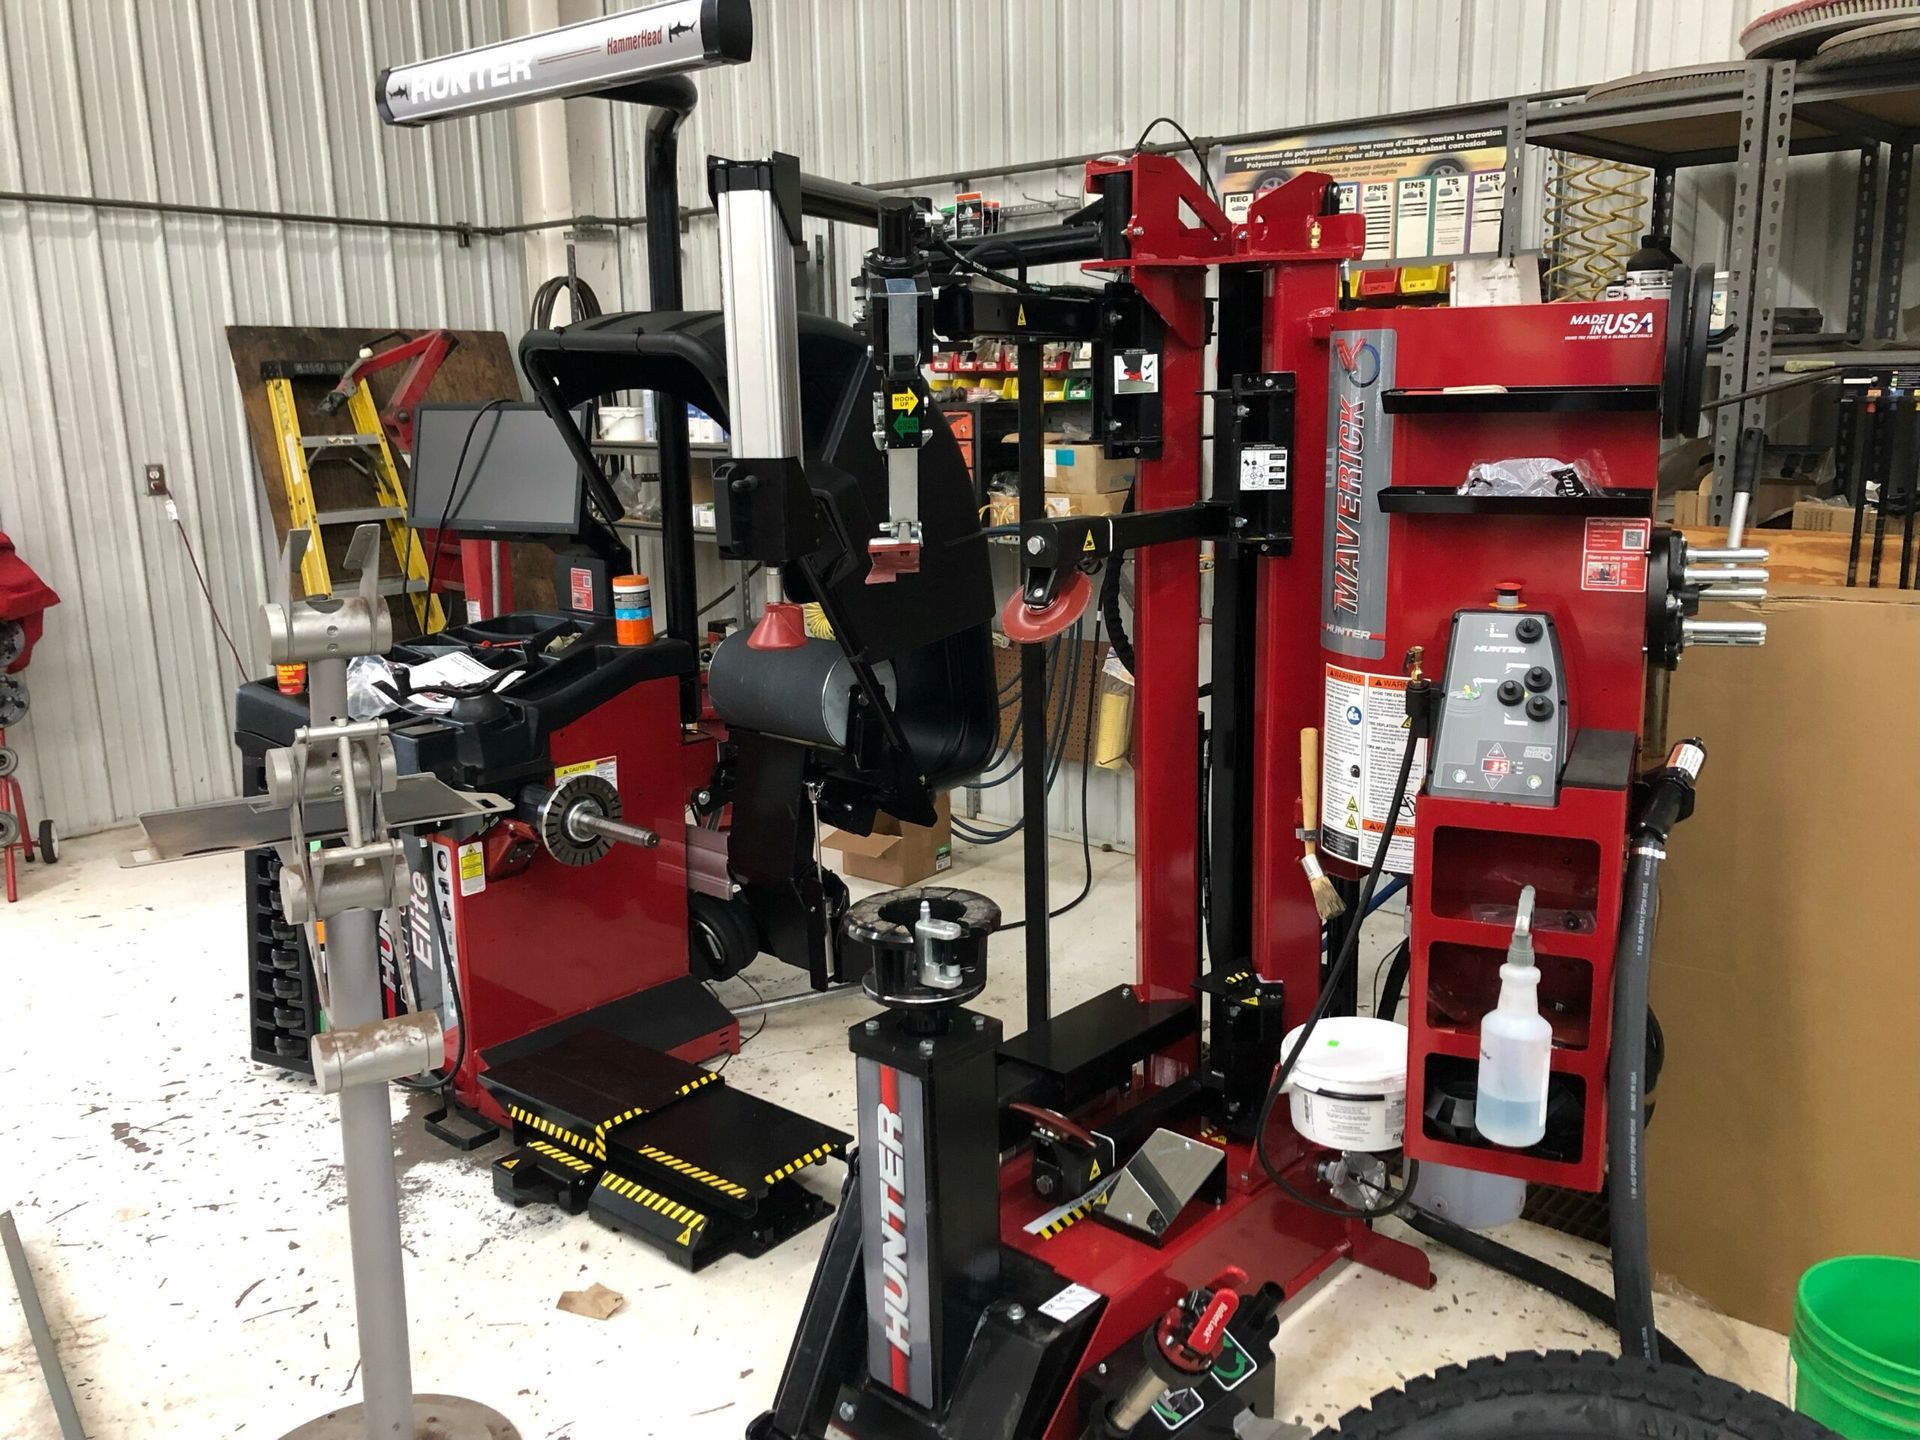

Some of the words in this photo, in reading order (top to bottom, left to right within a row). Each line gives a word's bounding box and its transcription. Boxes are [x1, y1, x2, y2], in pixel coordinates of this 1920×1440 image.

[606, 25, 663, 55] HammerHead
[411, 57, 532, 105] HUNTER
[1244, 152, 1283, 162] revêtement
[1295, 147, 1328, 157] polyester
[1329, 144, 1357, 155] protège
[1430, 135, 1455, 143] contre
[1466, 129, 1502, 139] corrosion
[1247, 160, 1280, 169] Polyester
[1282, 157, 1310, 167] coating
[1312, 154, 1343, 164] protects
[1344, 152, 1363, 160] your
[1365, 149, 1384, 158] alloy
[1386, 147, 1414, 155] wheels
[1415, 143, 1446, 153] against
[1448, 139, 1487, 150] corrosion
[1404, 181, 1425, 189] ENS
[1479, 175, 1500, 183] LHS
[1570, 314, 1607, 325] MADE
[1589, 325, 1604, 334] IN
[1604, 312, 1653, 334] USA
[1334, 394, 1365, 615] MAVERICK
[1326, 624, 1371, 640] HUNTER
[1473, 645, 1526, 654] HUNTER
[569, 764, 591, 773] CAUTION
[410, 871, 434, 970] Elite
[1638, 915, 1646, 935] SPRAY
[877, 1102, 910, 1358] HUNTER
